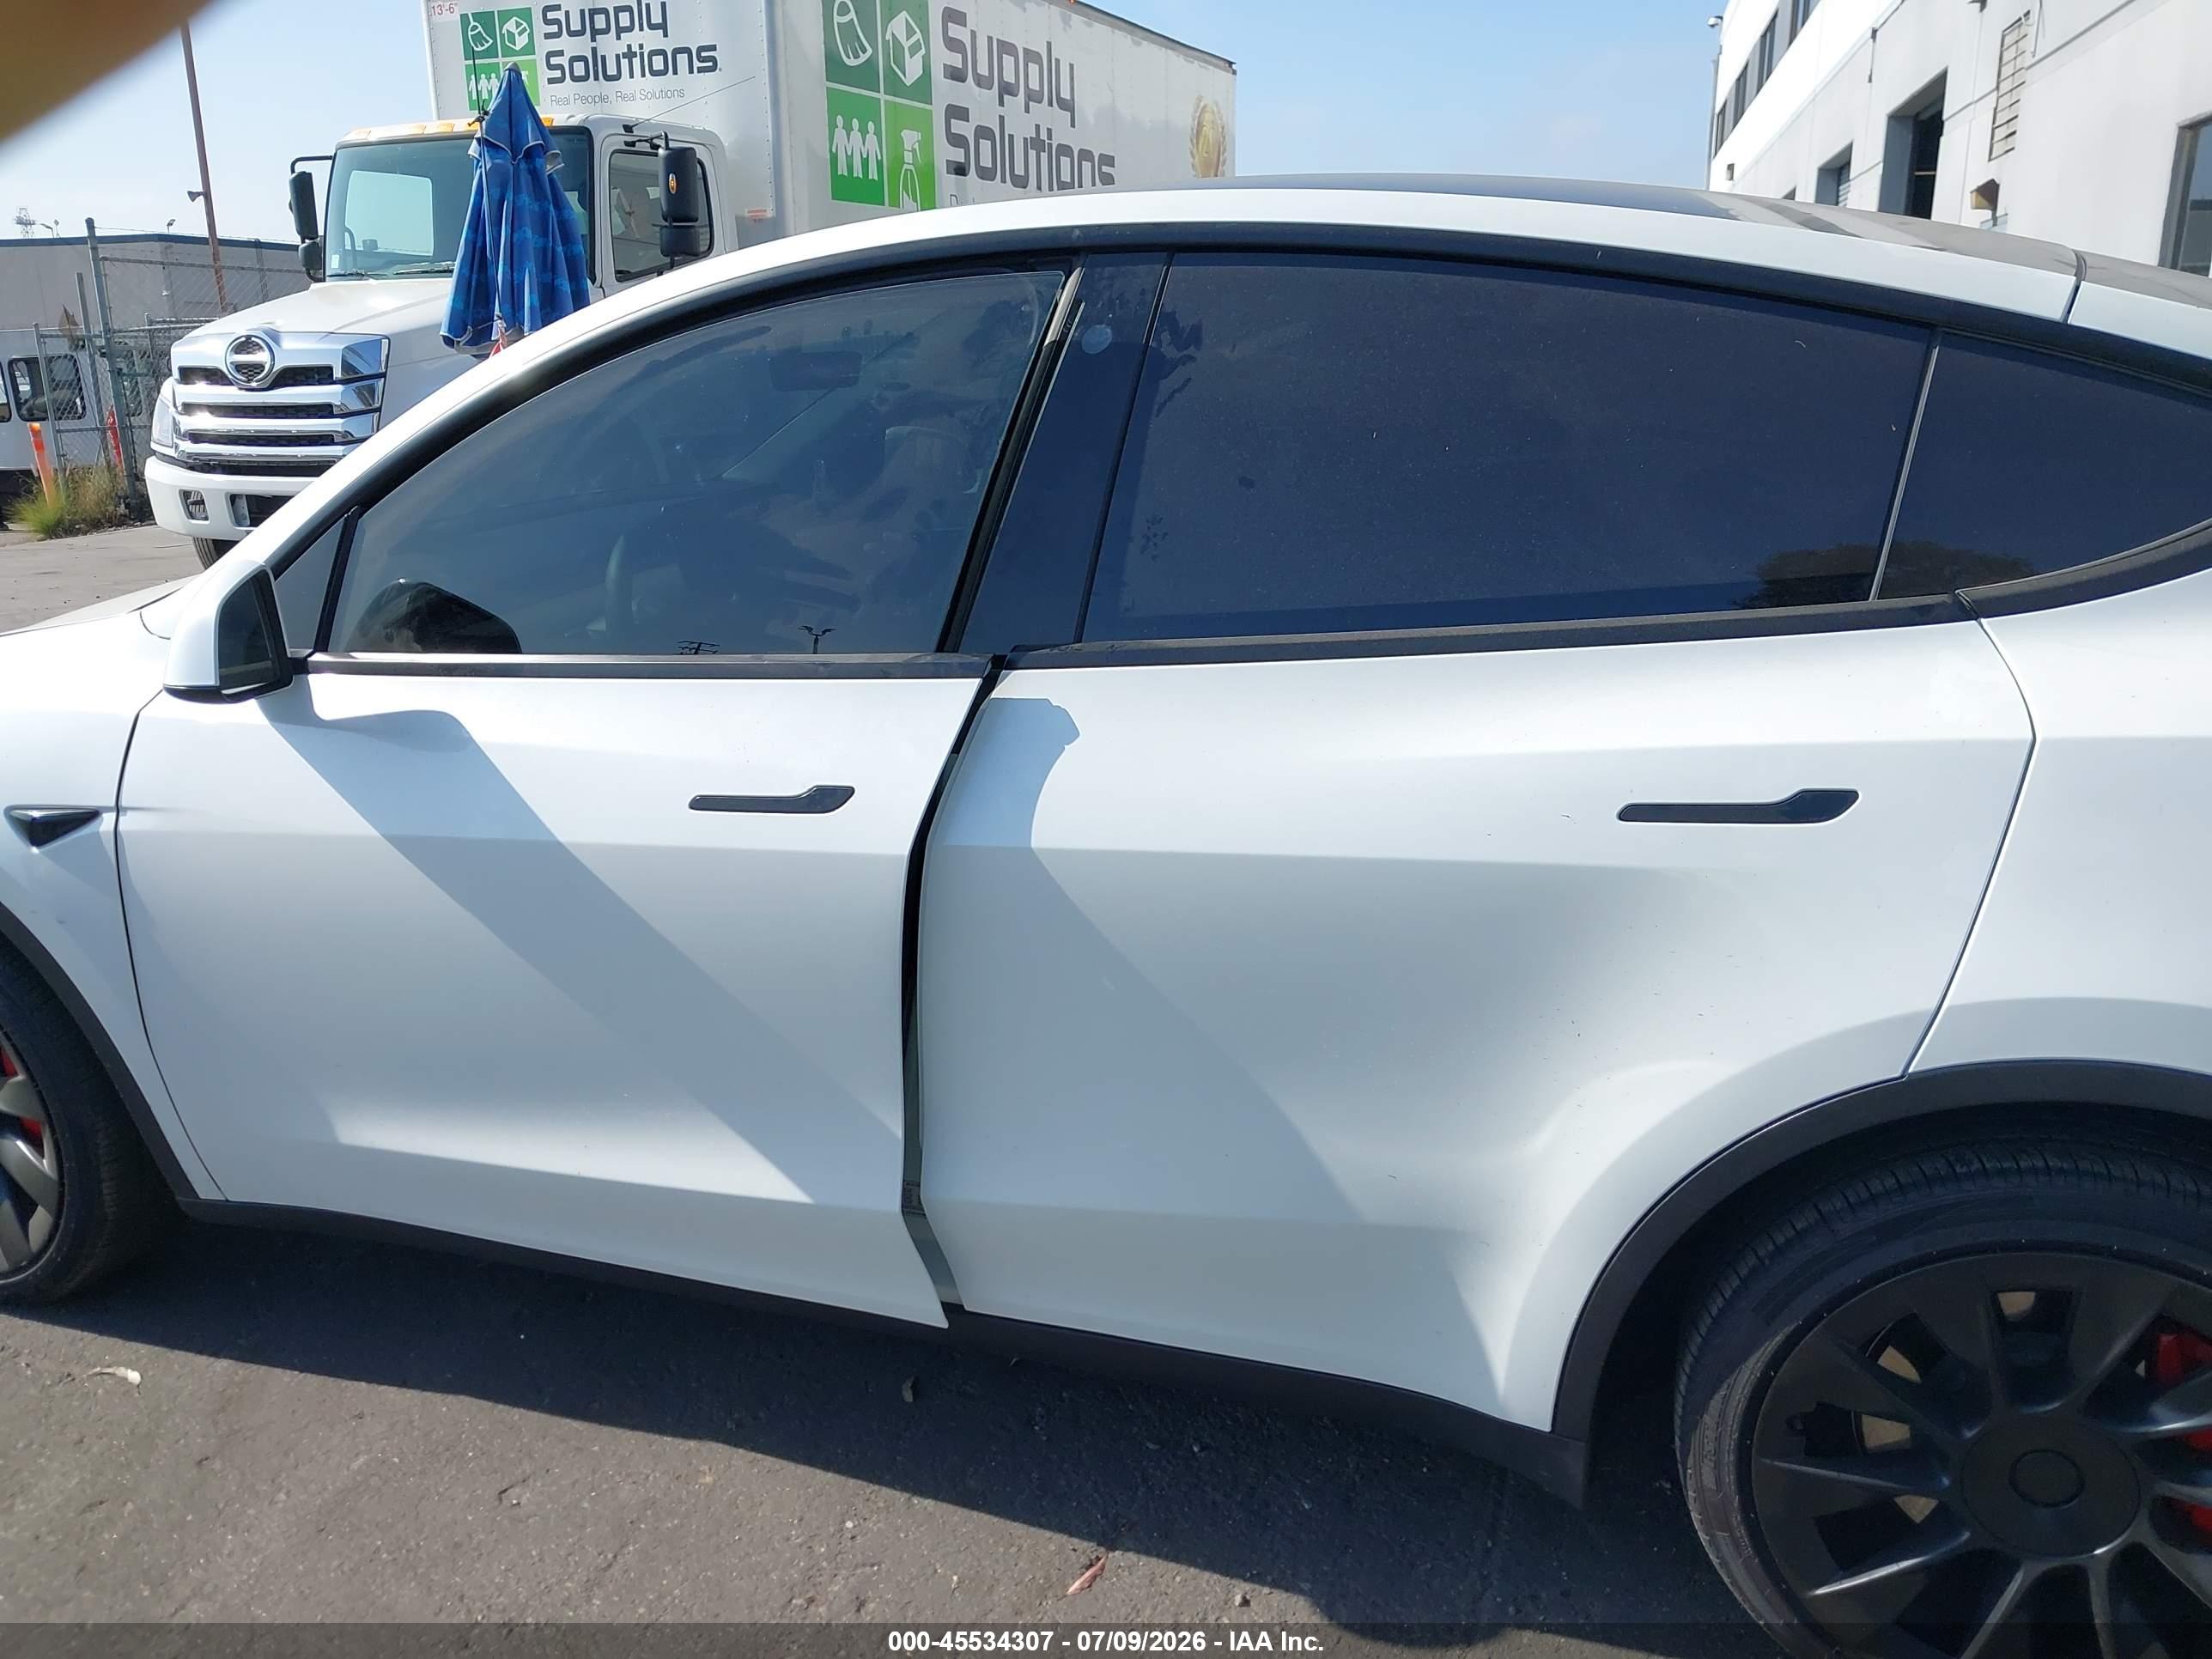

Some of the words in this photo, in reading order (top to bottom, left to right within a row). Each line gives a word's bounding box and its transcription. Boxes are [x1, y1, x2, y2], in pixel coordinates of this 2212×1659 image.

[542, 0, 669, 43] Supply
[544, 43, 719, 84] Solutions
[941, 6, 1077, 129] Supply
[550, 94, 571, 106] Real
[573, 91, 613, 106] People,
[615, 89, 638, 103] Real
[639, 87, 685, 101] Solutions
[944, 103, 1115, 192] Solutions
